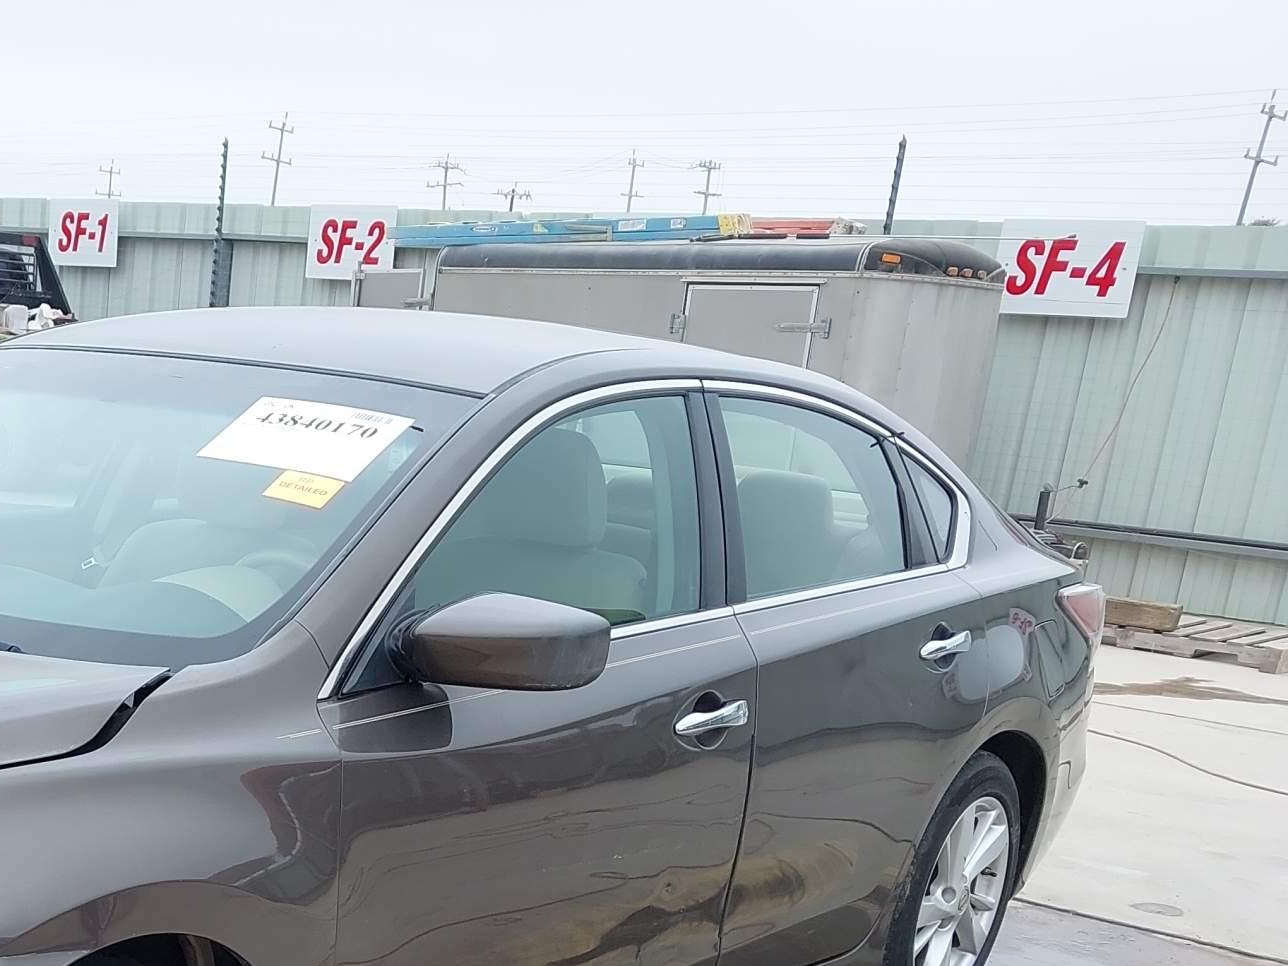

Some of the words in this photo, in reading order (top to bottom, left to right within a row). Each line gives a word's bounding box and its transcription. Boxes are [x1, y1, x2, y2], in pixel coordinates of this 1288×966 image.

[57, 211, 109, 252] SF-1
[316, 218, 386, 265] SF-2
[1005, 238, 1127, 298] SF-4
[256, 411, 380, 439] 43840170
[278, 480, 329, 497] DETAILED
